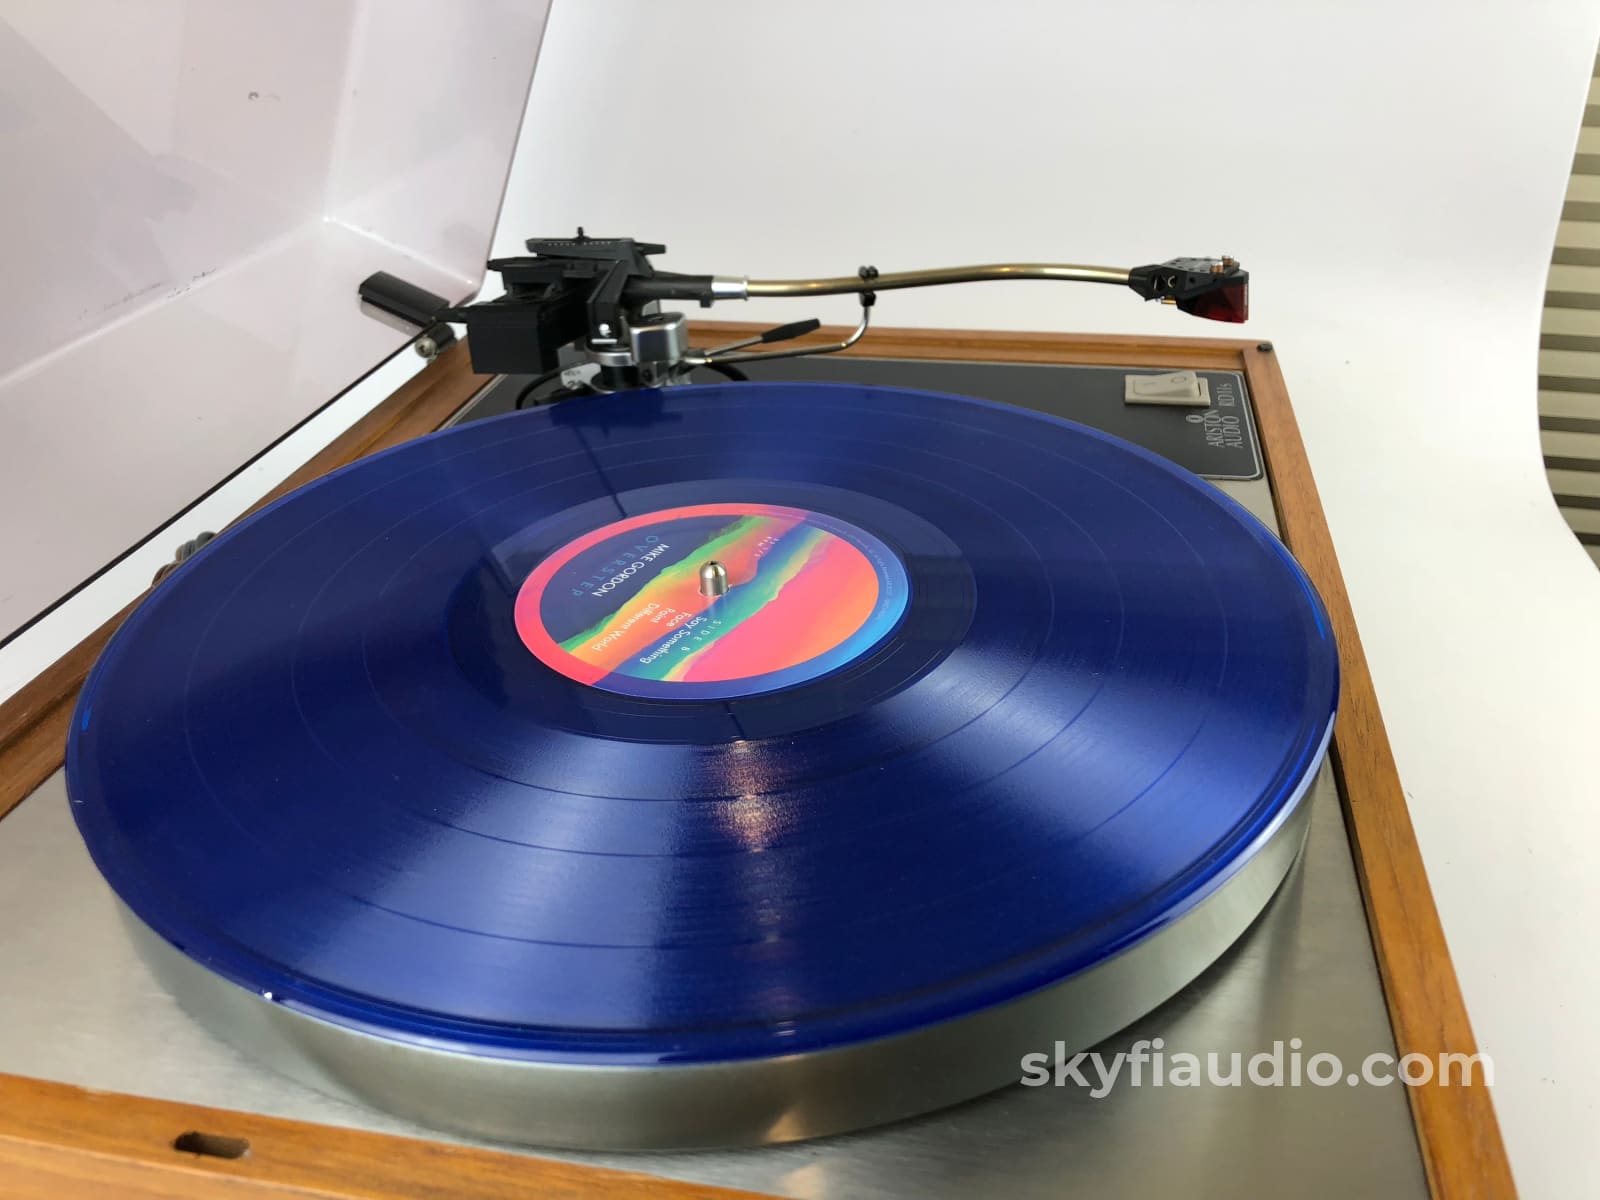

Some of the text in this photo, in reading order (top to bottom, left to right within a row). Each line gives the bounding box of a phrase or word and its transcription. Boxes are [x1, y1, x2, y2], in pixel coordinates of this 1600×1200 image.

[1203, 409, 1225, 448] ARISTON
[1221, 415, 1243, 449] AUDIO
[571, 535, 659, 596] OVERSTEP
[592, 543, 670, 597] MIKE GORDON
[666, 611, 692, 627] Face
[591, 630, 626, 652] World
[639, 616, 708, 664] Say Something
